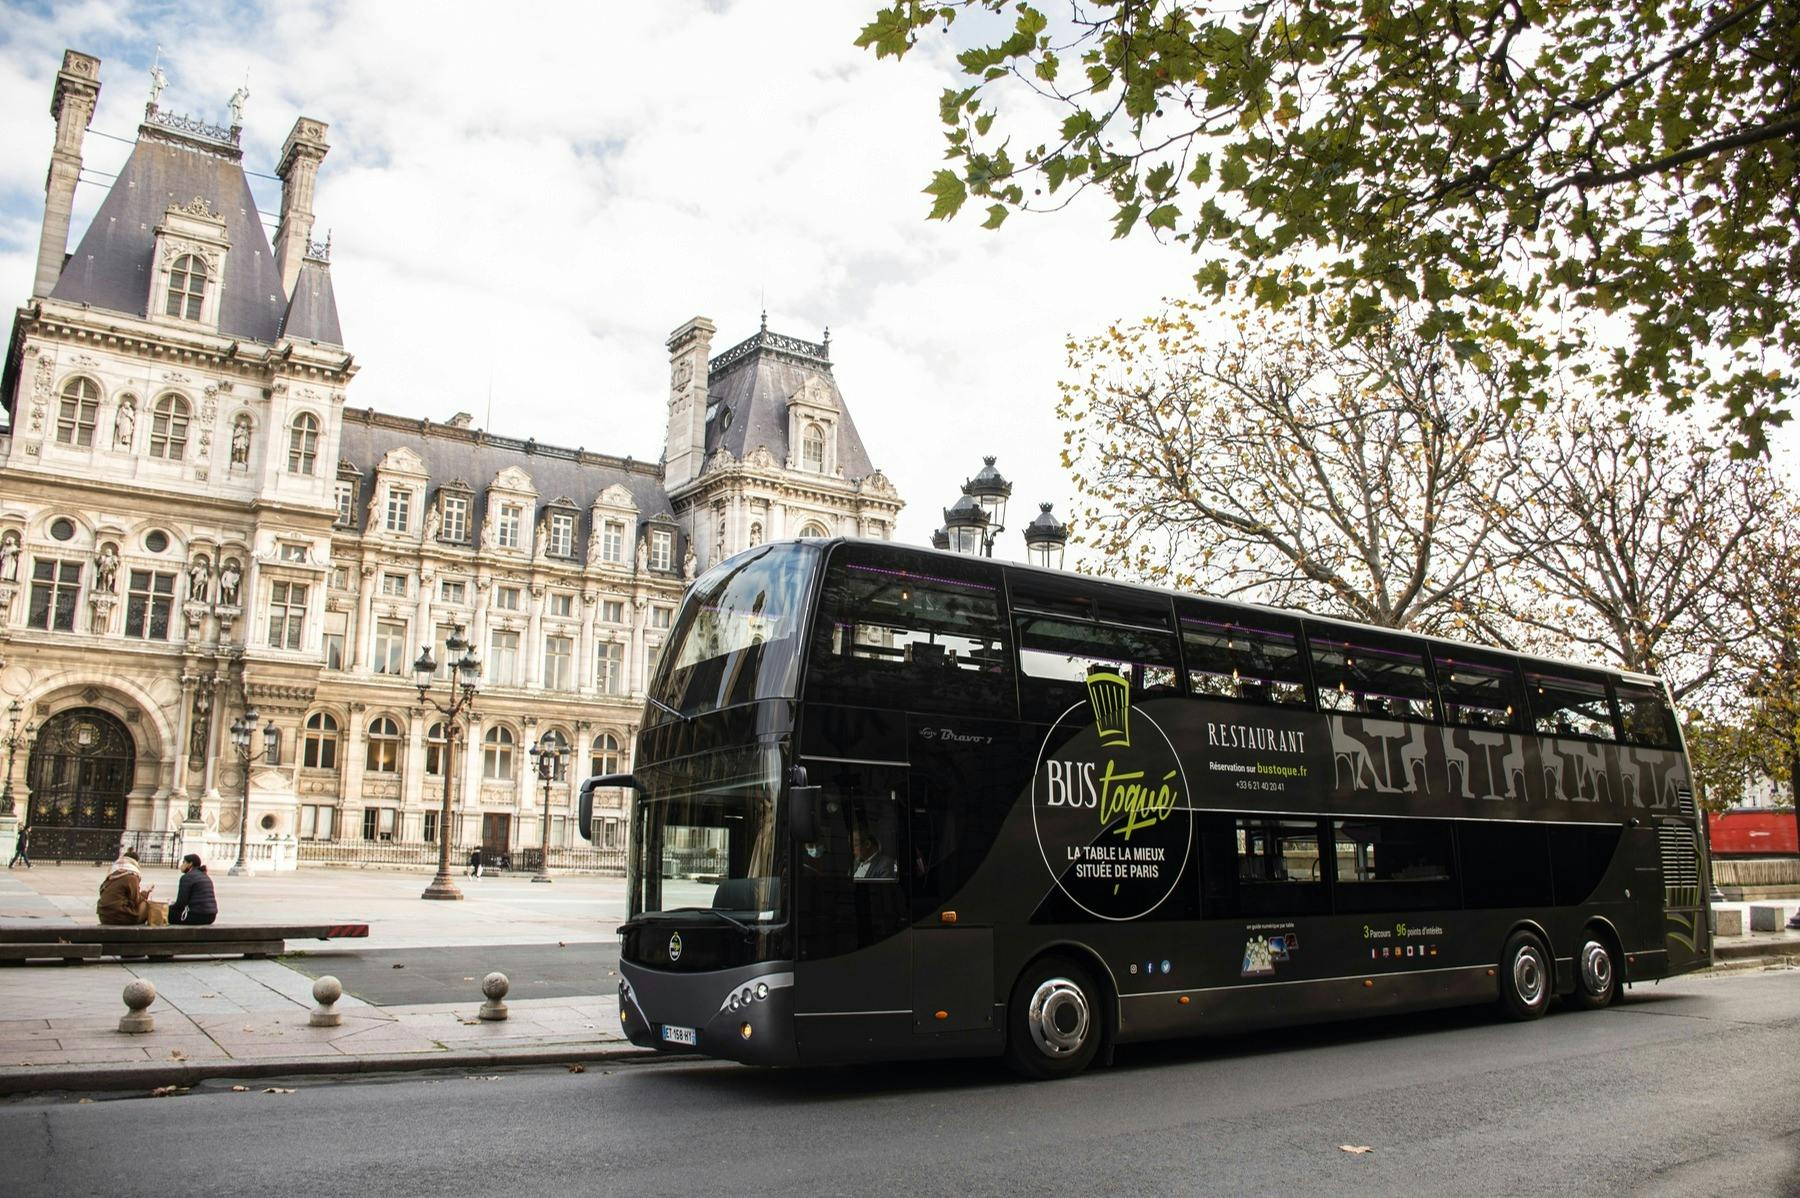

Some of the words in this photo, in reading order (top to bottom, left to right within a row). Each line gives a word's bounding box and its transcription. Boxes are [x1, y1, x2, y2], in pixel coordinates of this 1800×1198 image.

[940, 728, 984, 742] Bravo
[1207, 722, 1304, 753] RESTAURANT
[1209, 761, 1245, 773] Réservation
[1246, 765, 1256, 773] sur
[1257, 762, 1308, 777] bustoque.fr
[1236, 780, 1247, 790] +33
[1247, 781, 1252, 790] 6
[1252, 781, 1260, 790] 21
[1261, 782, 1269, 791] 40
[1270, 782, 1277, 791] 20
[1278, 783, 1285, 791] 41
[1046, 760, 1098, 808] BUS
[1099, 759, 1177, 840] toqué
[1067, 846, 1081, 860] LA
[1083, 846, 1116, 860] TABLE
[1118, 847, 1132, 861] LA
[1133, 847, 1165, 861] MIEUX
[1076, 861, 1113, 878] SITUÉE
[1114, 864, 1128, 878] DE
[1130, 864, 1159, 878] PARIS
[1363, 925, 1370, 939] 3
[1370, 929, 1391, 938] Parcours
[1396, 923, 1407, 937] 96
[1407, 928, 1422, 938] points
